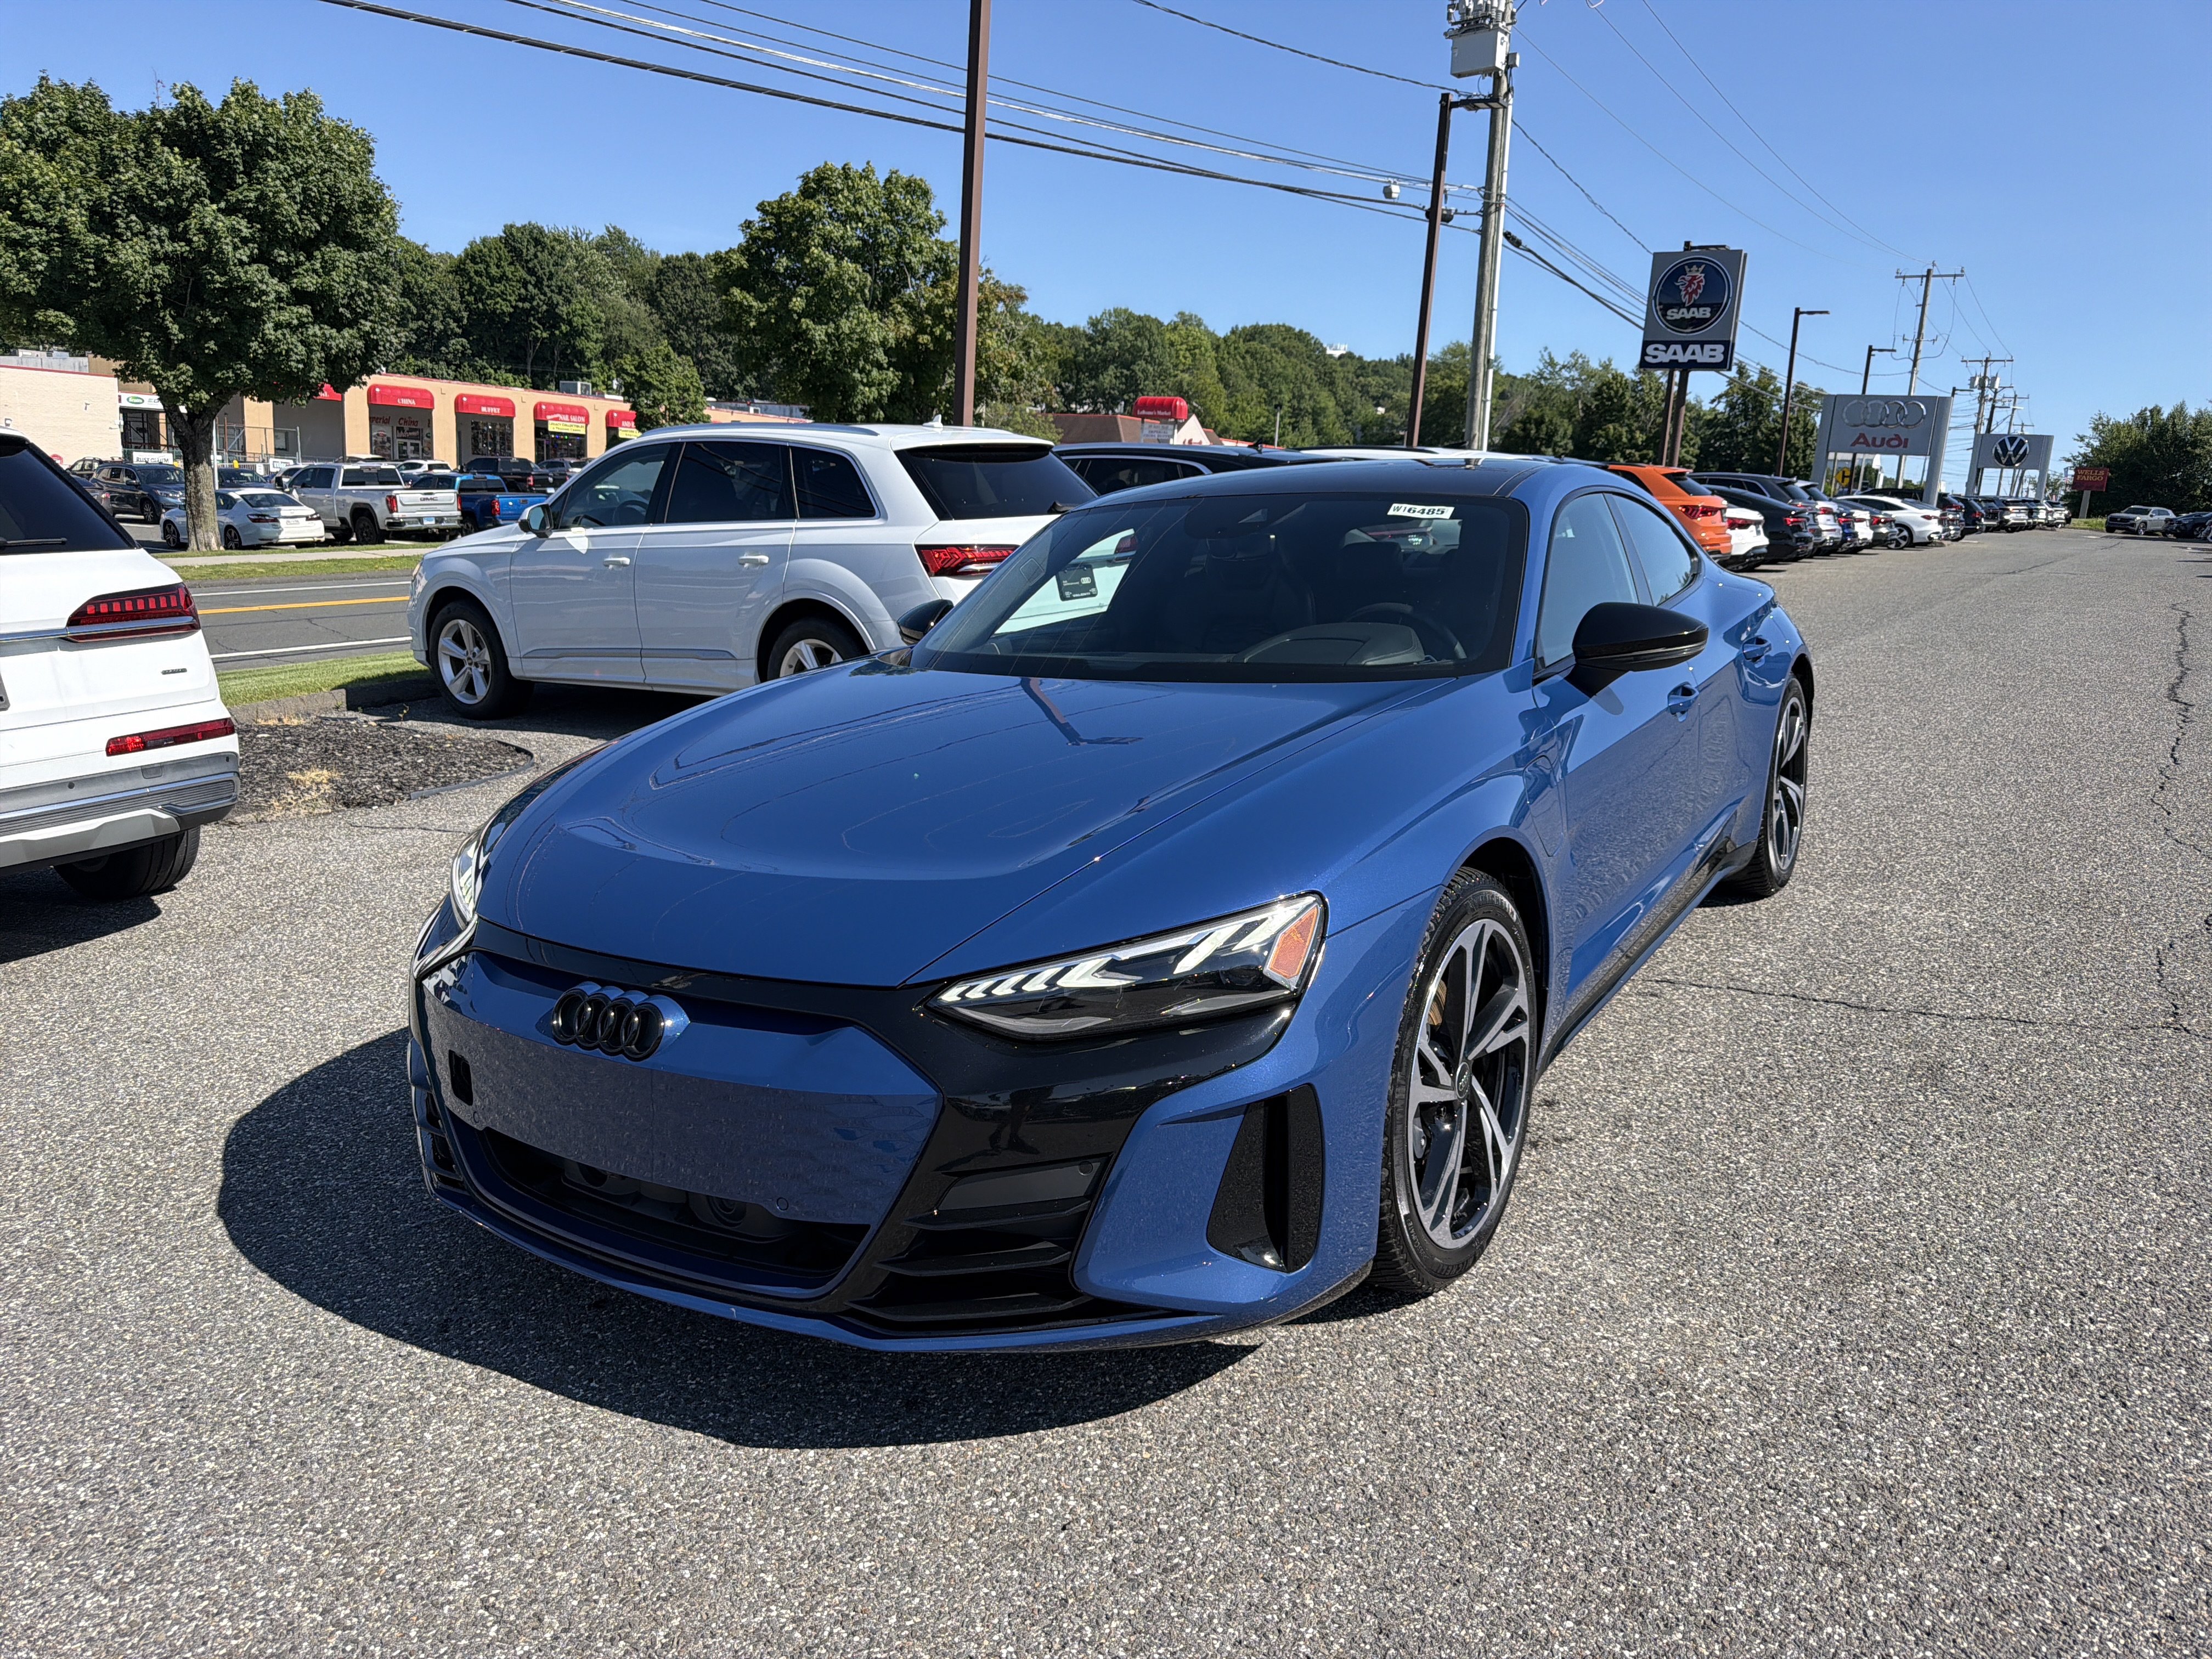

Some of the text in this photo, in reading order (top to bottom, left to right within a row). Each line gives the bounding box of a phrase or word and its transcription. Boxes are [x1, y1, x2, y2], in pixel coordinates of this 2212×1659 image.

[1666, 307, 1711, 320] SAAB
[1644, 343, 1725, 363] SAAB
[398, 416, 419, 427] China
[559, 413, 569, 421] NAIL
[1850, 432, 1909, 449] Audi
[1393, 505, 1446, 515] W16485
